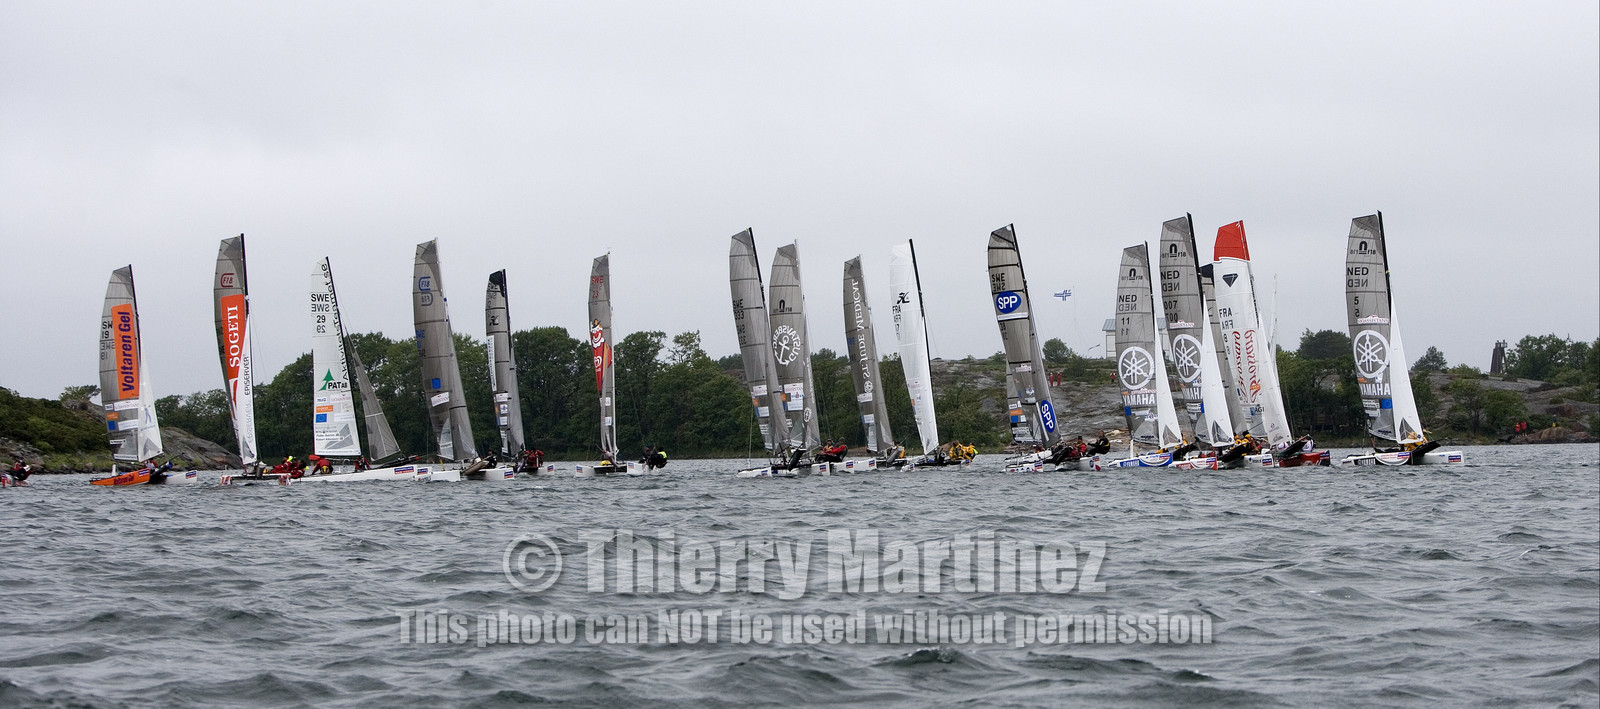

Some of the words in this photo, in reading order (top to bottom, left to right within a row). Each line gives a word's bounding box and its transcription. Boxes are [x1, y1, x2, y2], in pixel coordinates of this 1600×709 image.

[1160, 270, 1180, 280] NED
[1347, 266, 1369, 276] NED
[991, 273, 1006, 283] SWE
[310, 293, 330, 303] SWE
[998, 295, 1018, 310] SPP
[1118, 294, 1138, 303] NED
[1353, 296, 1360, 306] 5
[1164, 300, 1178, 310] 007
[1218, 307, 1233, 319] FRA
[118, 311, 131, 332] Gel
[316, 314, 326, 324] 29
[1121, 316, 1130, 325] 11
[227, 305, 241, 368] SOGETI
[121, 335, 134, 392] Voltaren
[327, 382, 341, 390] PAT
[1122, 393, 1156, 406] YAMAHA
[1041, 403, 1054, 429] SPP
